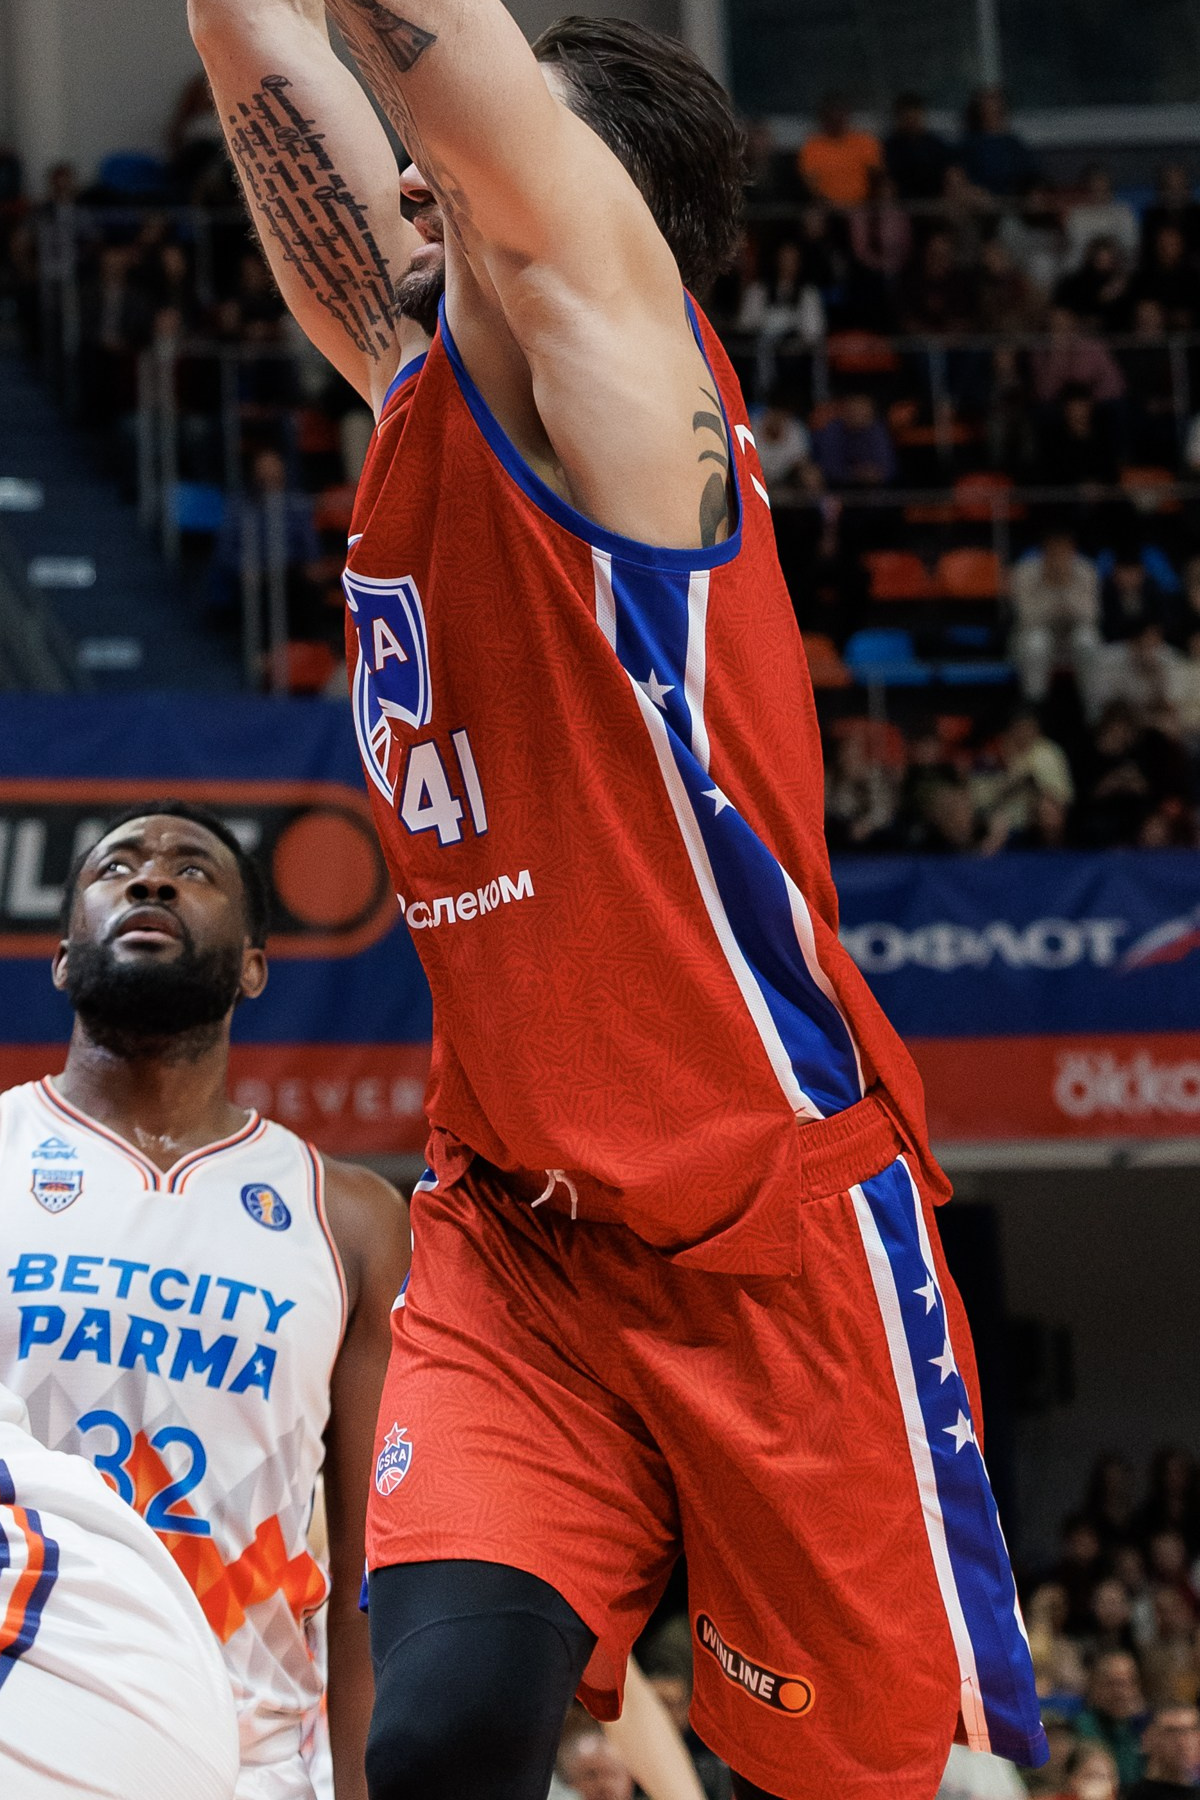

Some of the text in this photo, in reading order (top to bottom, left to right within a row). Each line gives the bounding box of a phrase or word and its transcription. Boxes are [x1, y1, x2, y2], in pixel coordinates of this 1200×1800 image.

[840, 917, 1128, 973] ОФЛОТ
[7, 1253, 297, 1334] BETCITY
[17, 1305, 277, 1402] PARMA
[76, 1410, 211, 1535] 32
[378, 1449, 406, 1472] CSKA
[703, 1620, 775, 1699] WINLINE
